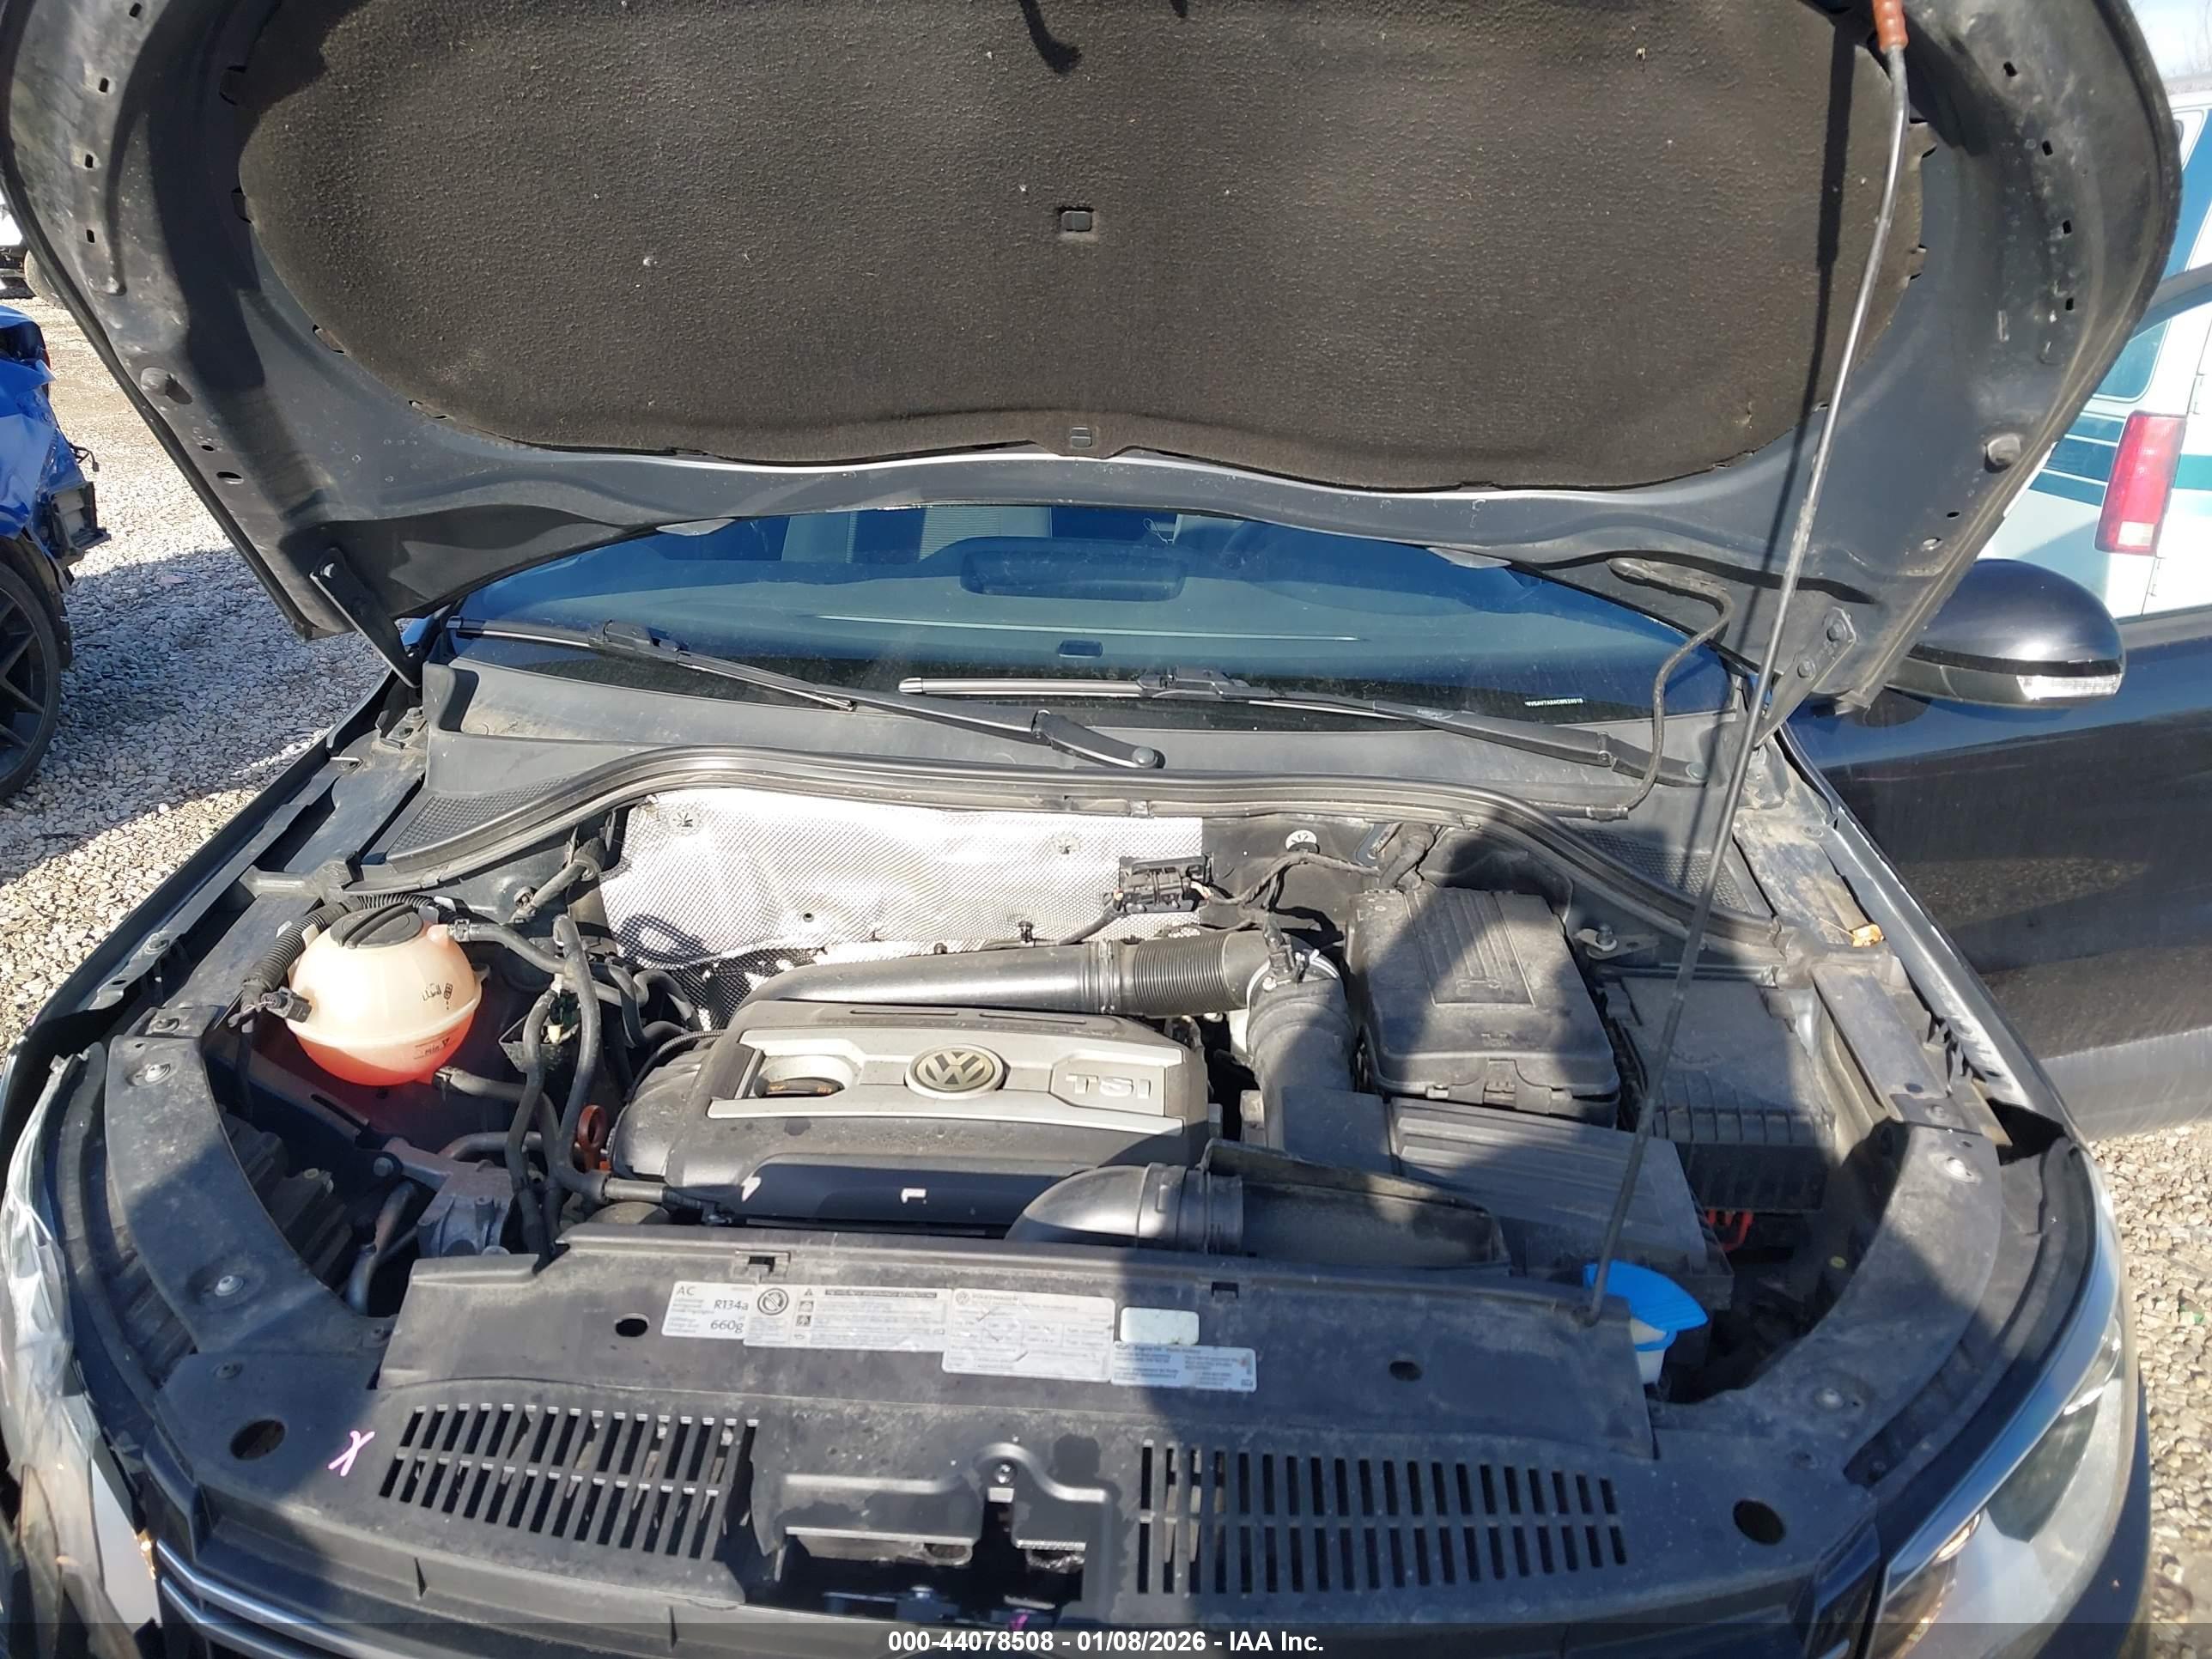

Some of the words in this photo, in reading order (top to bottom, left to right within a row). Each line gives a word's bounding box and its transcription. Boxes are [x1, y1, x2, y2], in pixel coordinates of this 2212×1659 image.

[1066, 1073, 1152, 1100] TSI
[676, 1285, 696, 1297] AC
[714, 1299, 750, 1312] R134a
[709, 1319, 744, 1334] 660g
